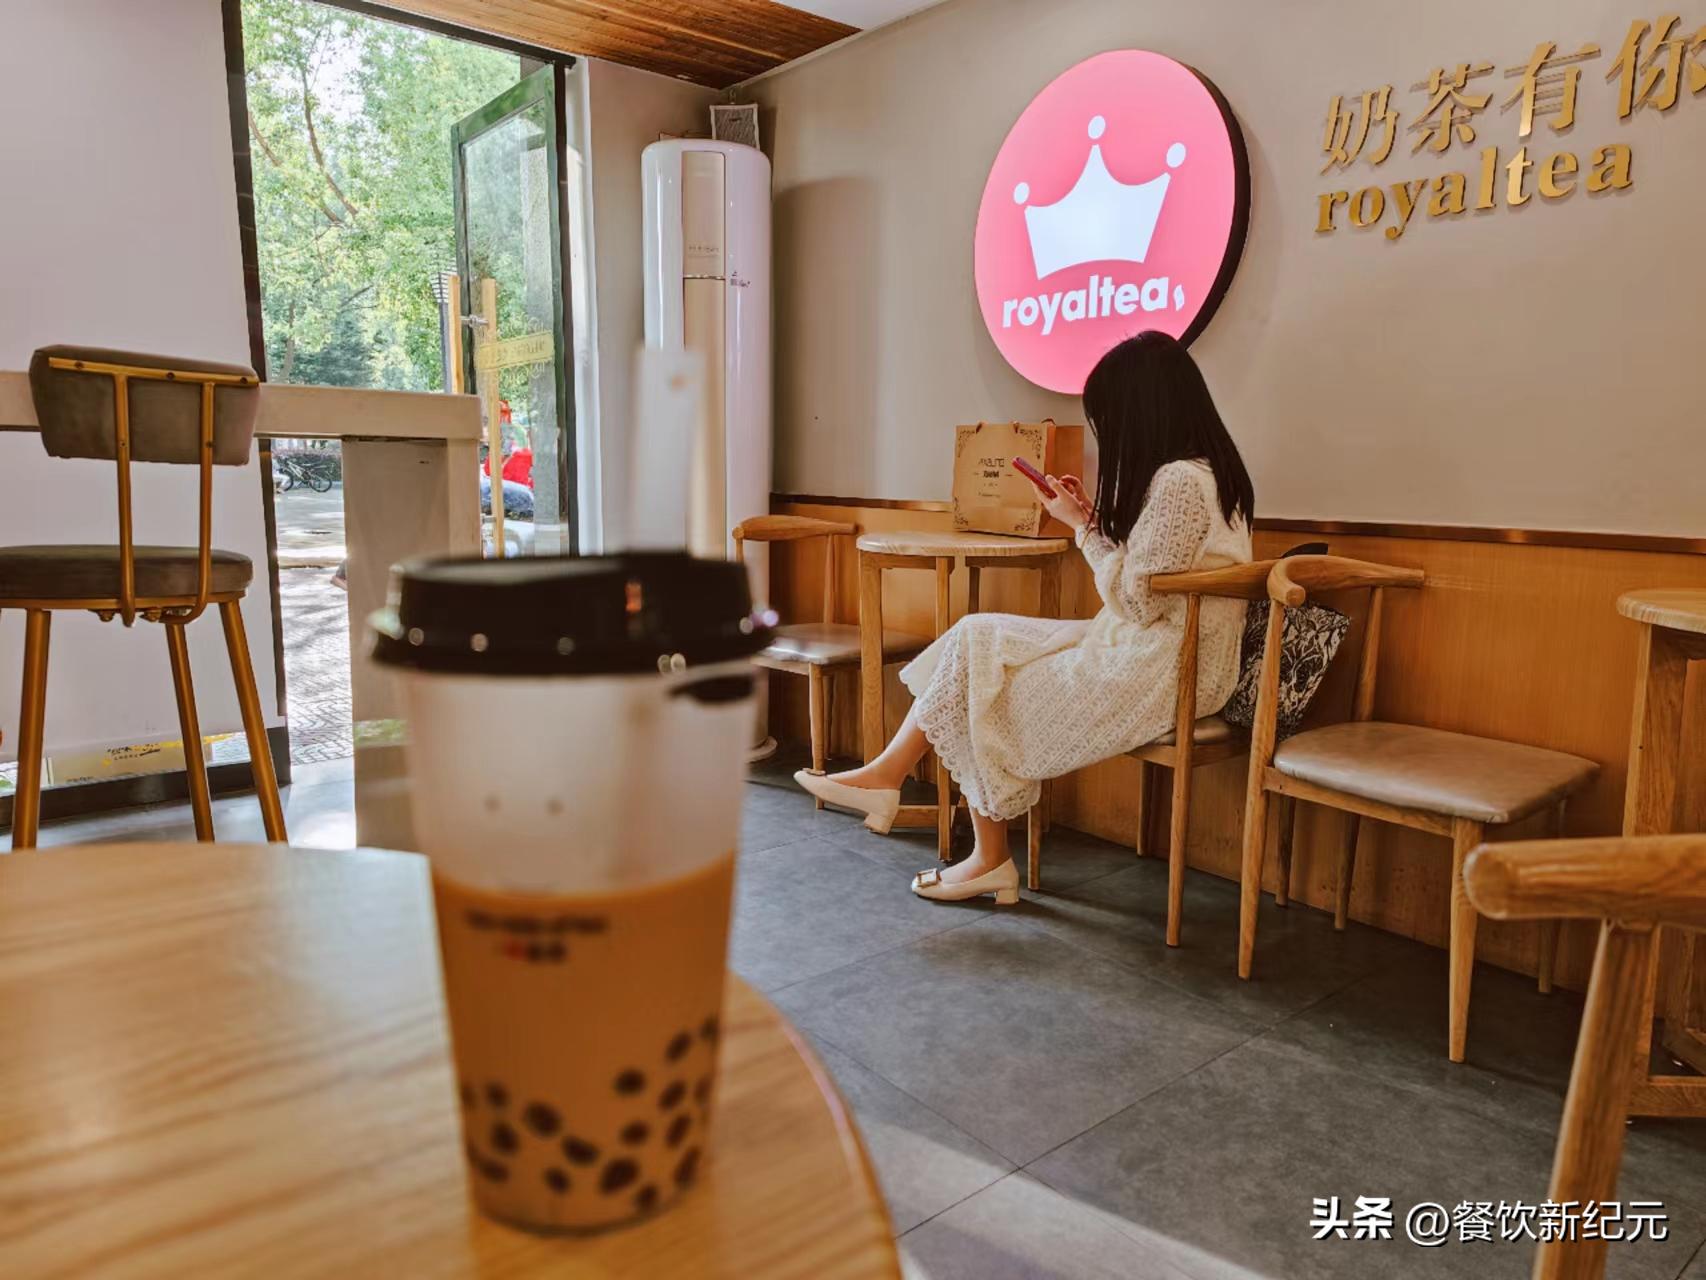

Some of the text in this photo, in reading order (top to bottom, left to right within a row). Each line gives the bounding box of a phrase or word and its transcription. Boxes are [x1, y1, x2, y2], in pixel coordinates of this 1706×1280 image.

[1320, 14, 1706, 176] 奶茶有你
[1315, 142, 1634, 240] royaltea
[1002, 275, 1169, 336] royaltea
